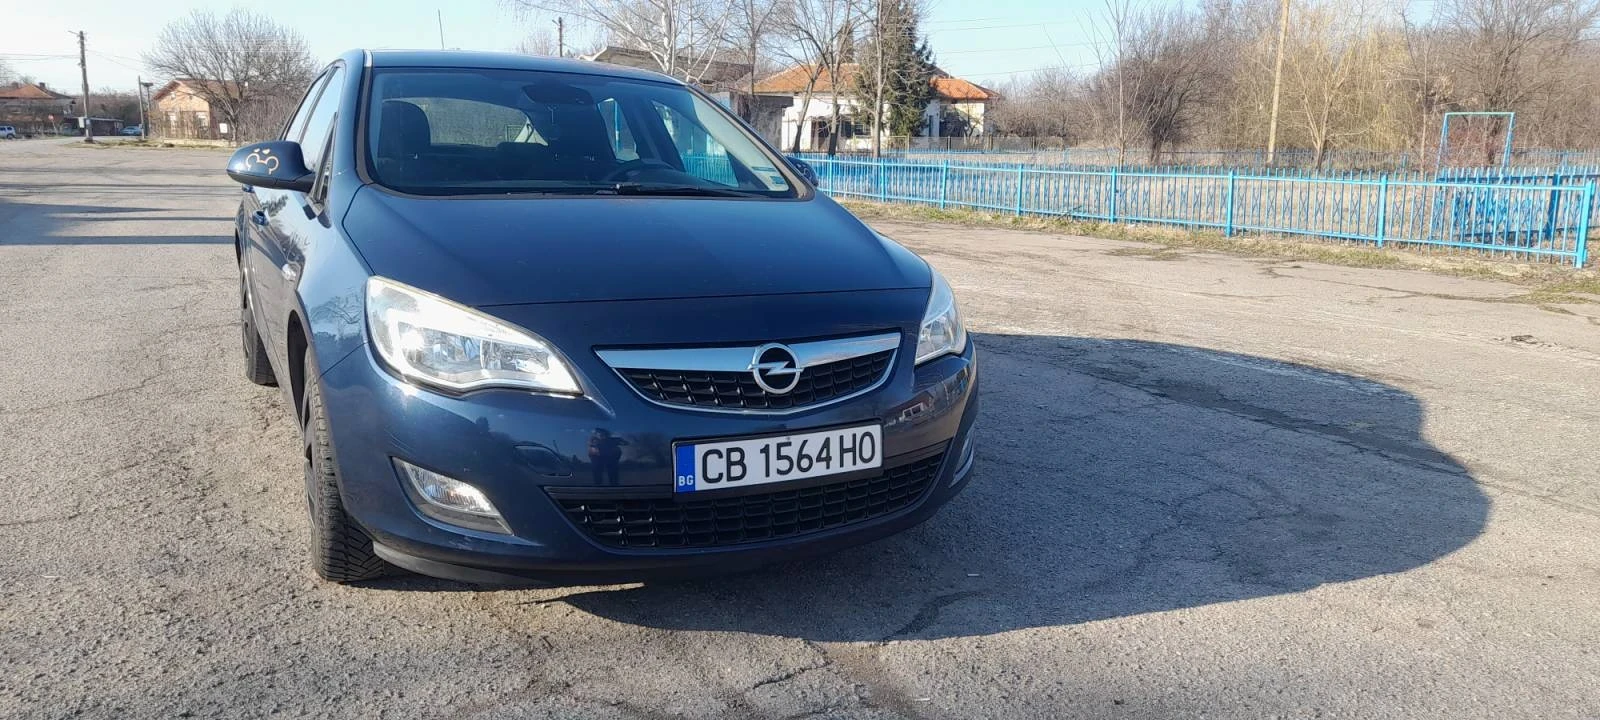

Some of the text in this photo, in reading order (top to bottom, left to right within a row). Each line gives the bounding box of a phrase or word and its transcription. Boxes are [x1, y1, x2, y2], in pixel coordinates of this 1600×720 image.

[702, 447, 747, 484] CB
[760, 436, 832, 478] 1564
[678, 475, 694, 486] BG
